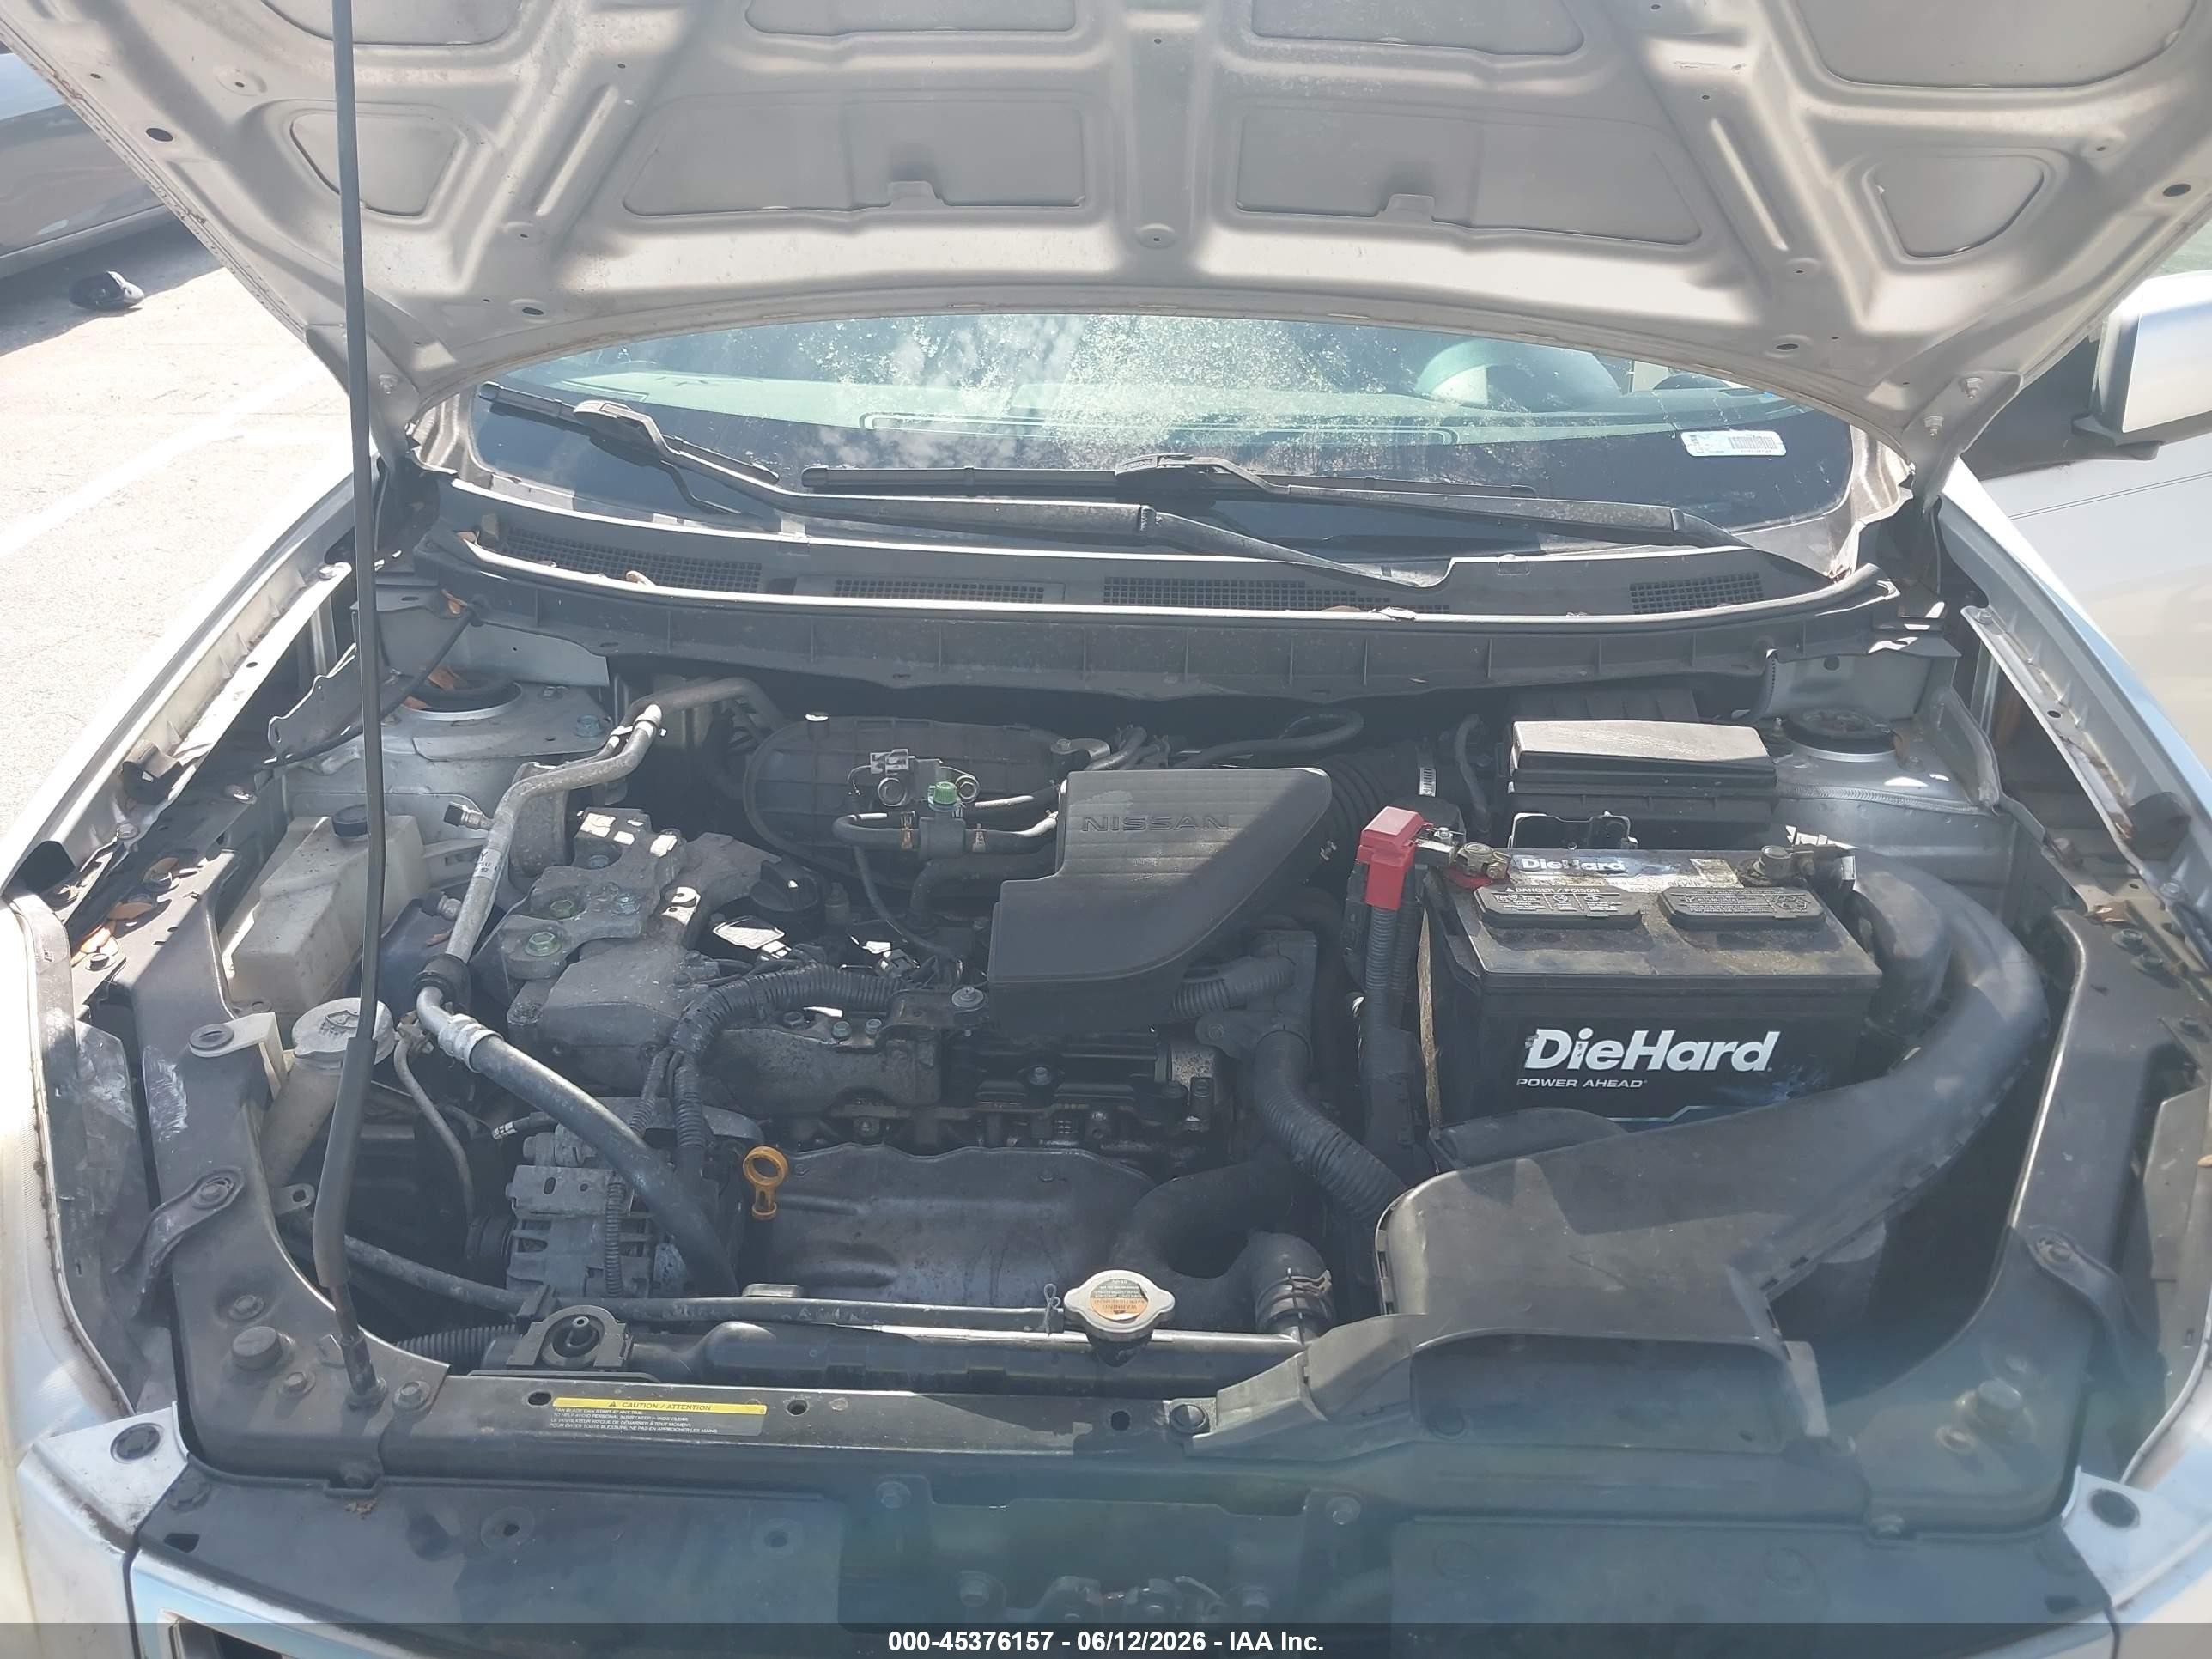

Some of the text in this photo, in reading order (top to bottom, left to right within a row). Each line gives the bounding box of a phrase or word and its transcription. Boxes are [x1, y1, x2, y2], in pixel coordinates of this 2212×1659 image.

[1082, 816, 1229, 832] NISSAN
[1524, 1027, 1781, 1072] DieHard
[1516, 1079, 1644, 1088] POWER AHEAD
